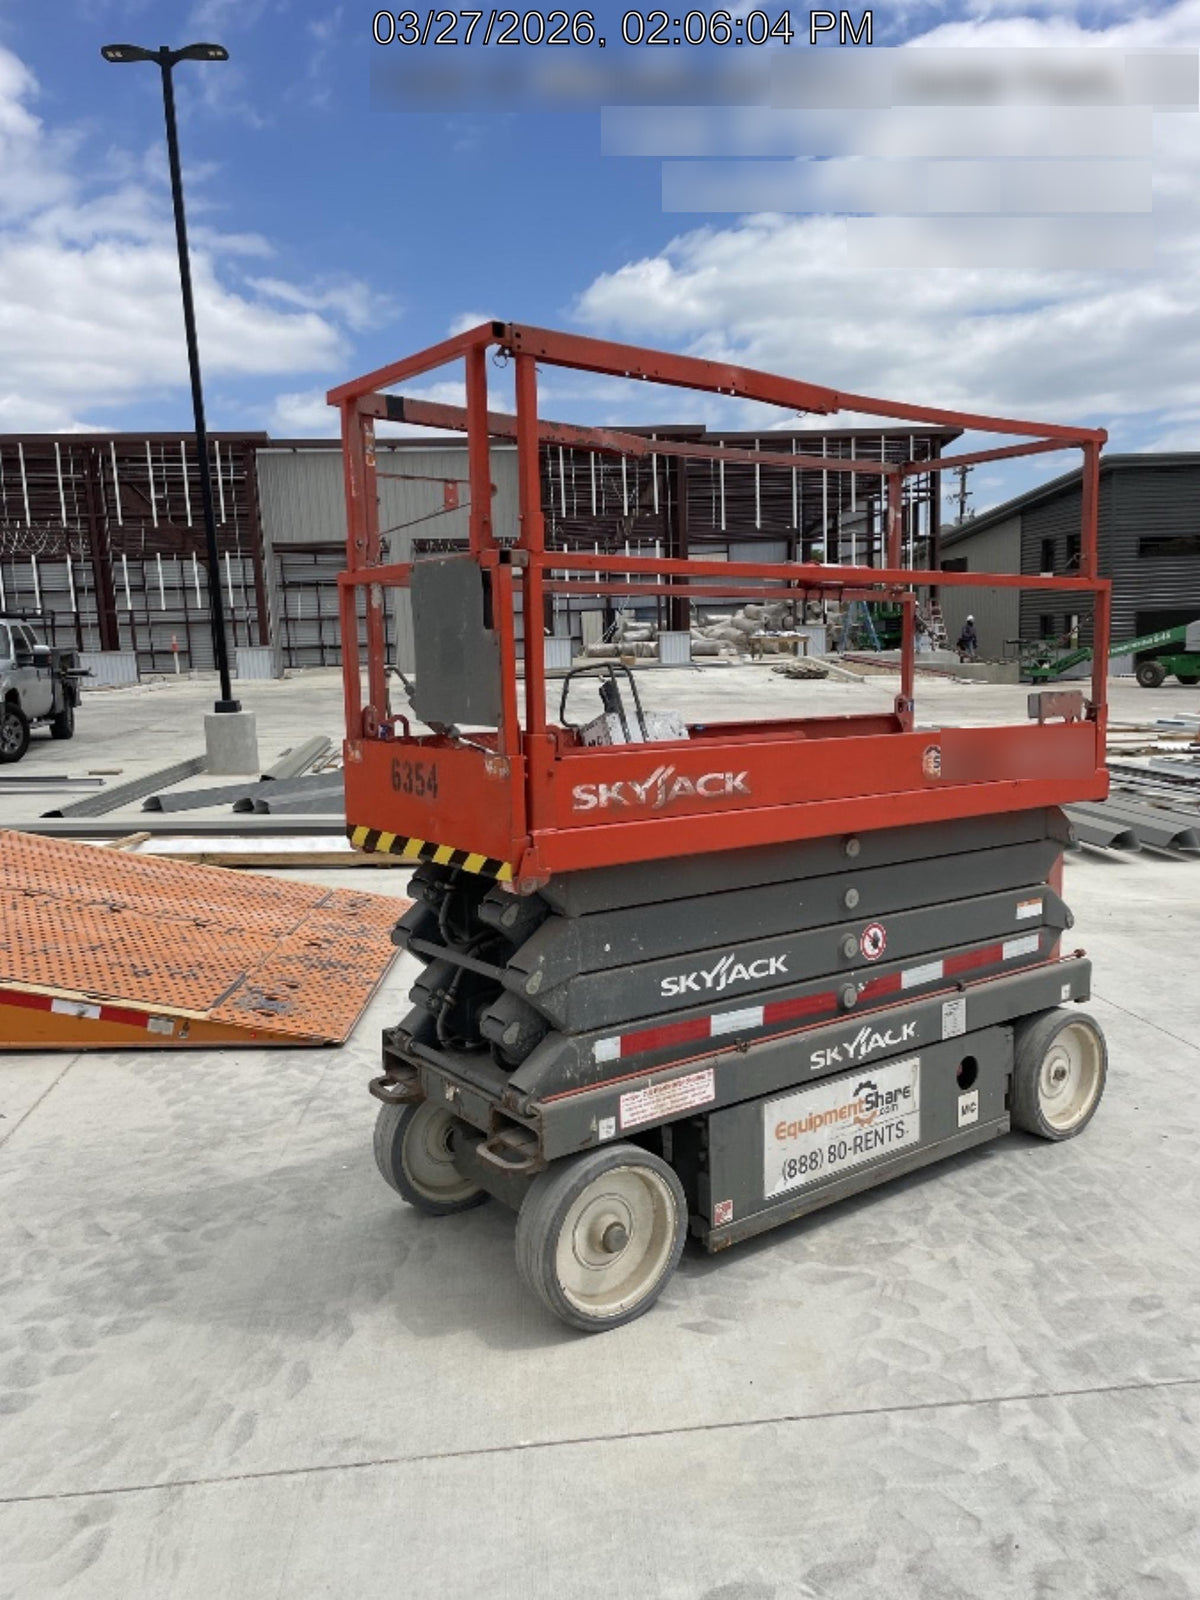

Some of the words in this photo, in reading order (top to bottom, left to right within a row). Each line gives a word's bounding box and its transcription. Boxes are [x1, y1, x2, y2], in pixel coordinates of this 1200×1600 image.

[391, 757, 438, 799] 6354
[571, 764, 751, 811] SKYJACK
[660, 953, 789, 997] SKYJACK
[809, 1021, 918, 1070] SKYJACK
[774, 1085, 911, 1141] EquipmentShare
[782, 1148, 824, 1186] (888)
[827, 1120, 905, 1164] 80-RENTS
